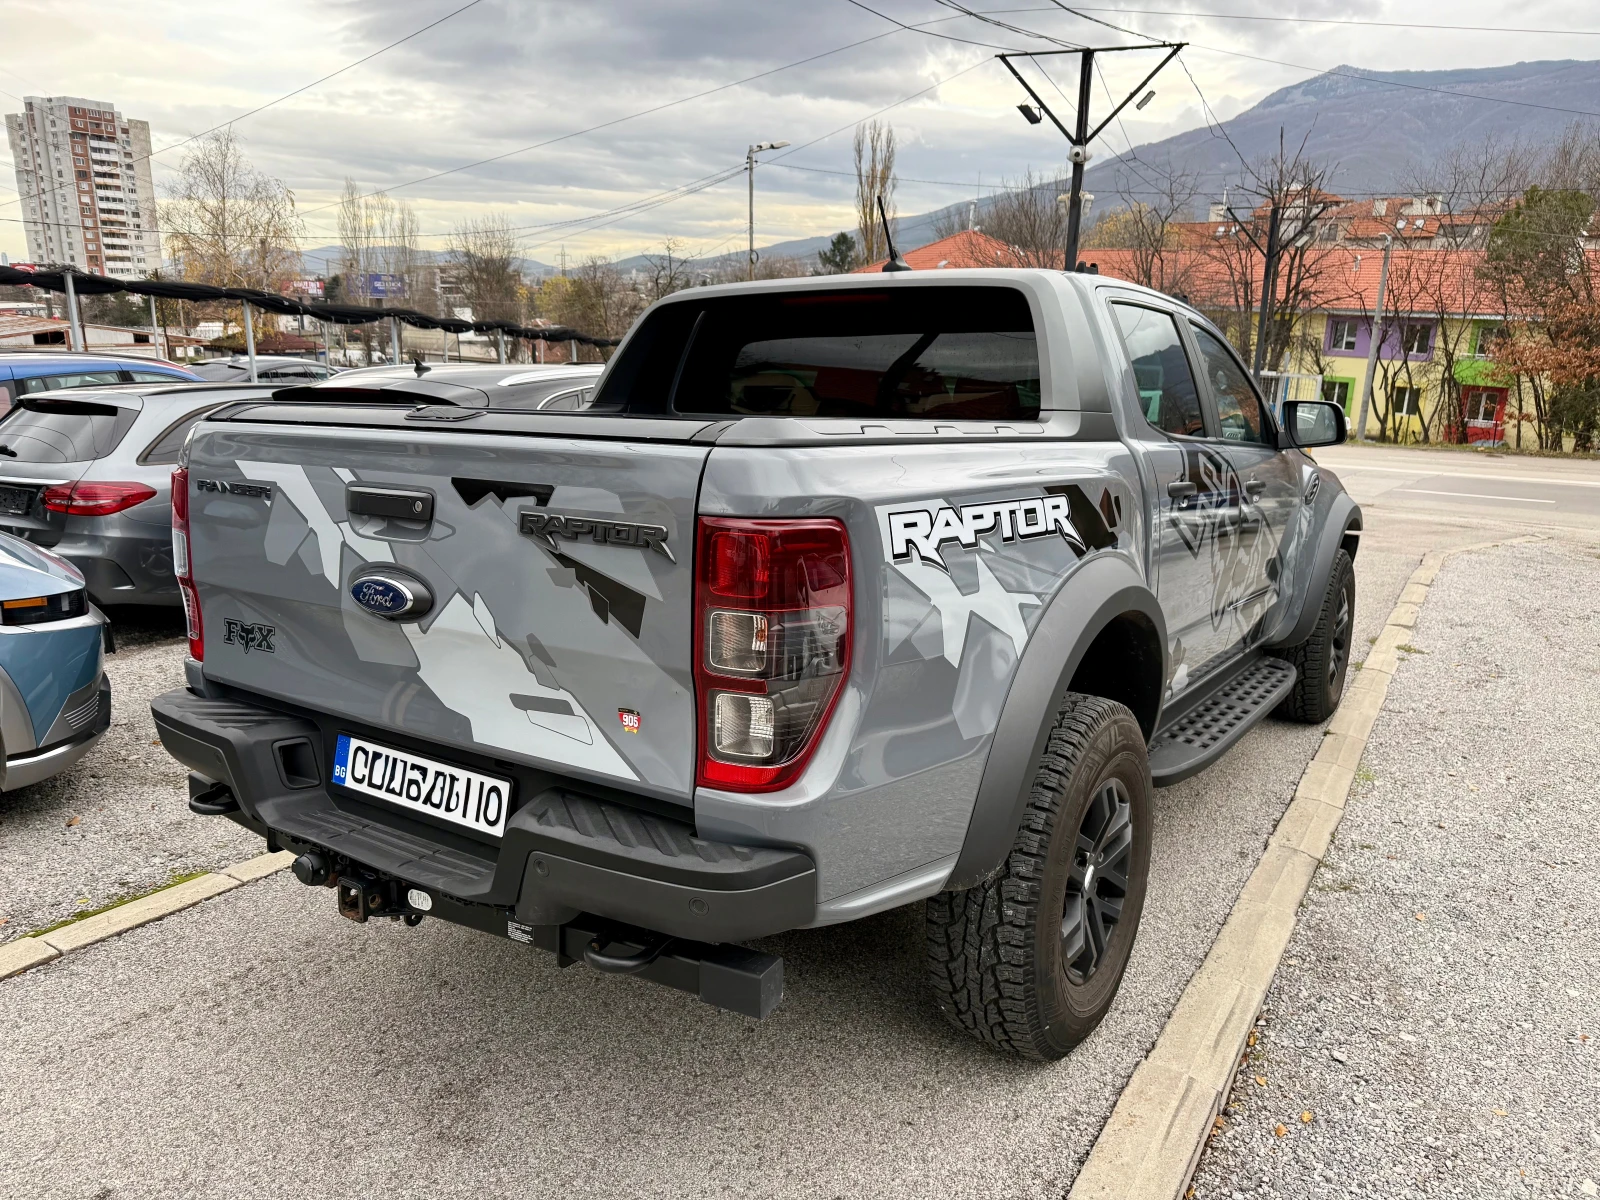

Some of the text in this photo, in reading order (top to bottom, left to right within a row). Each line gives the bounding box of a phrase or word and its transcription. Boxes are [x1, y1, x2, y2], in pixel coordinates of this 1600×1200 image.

[197, 479, 271, 499] RANGER
[520, 511, 676, 564] RAPTOR
[889, 494, 1086, 574] RAPTOR
[360, 582, 393, 607] Ford
[622, 714, 639, 728] 905
[334, 764, 346, 778] BG
